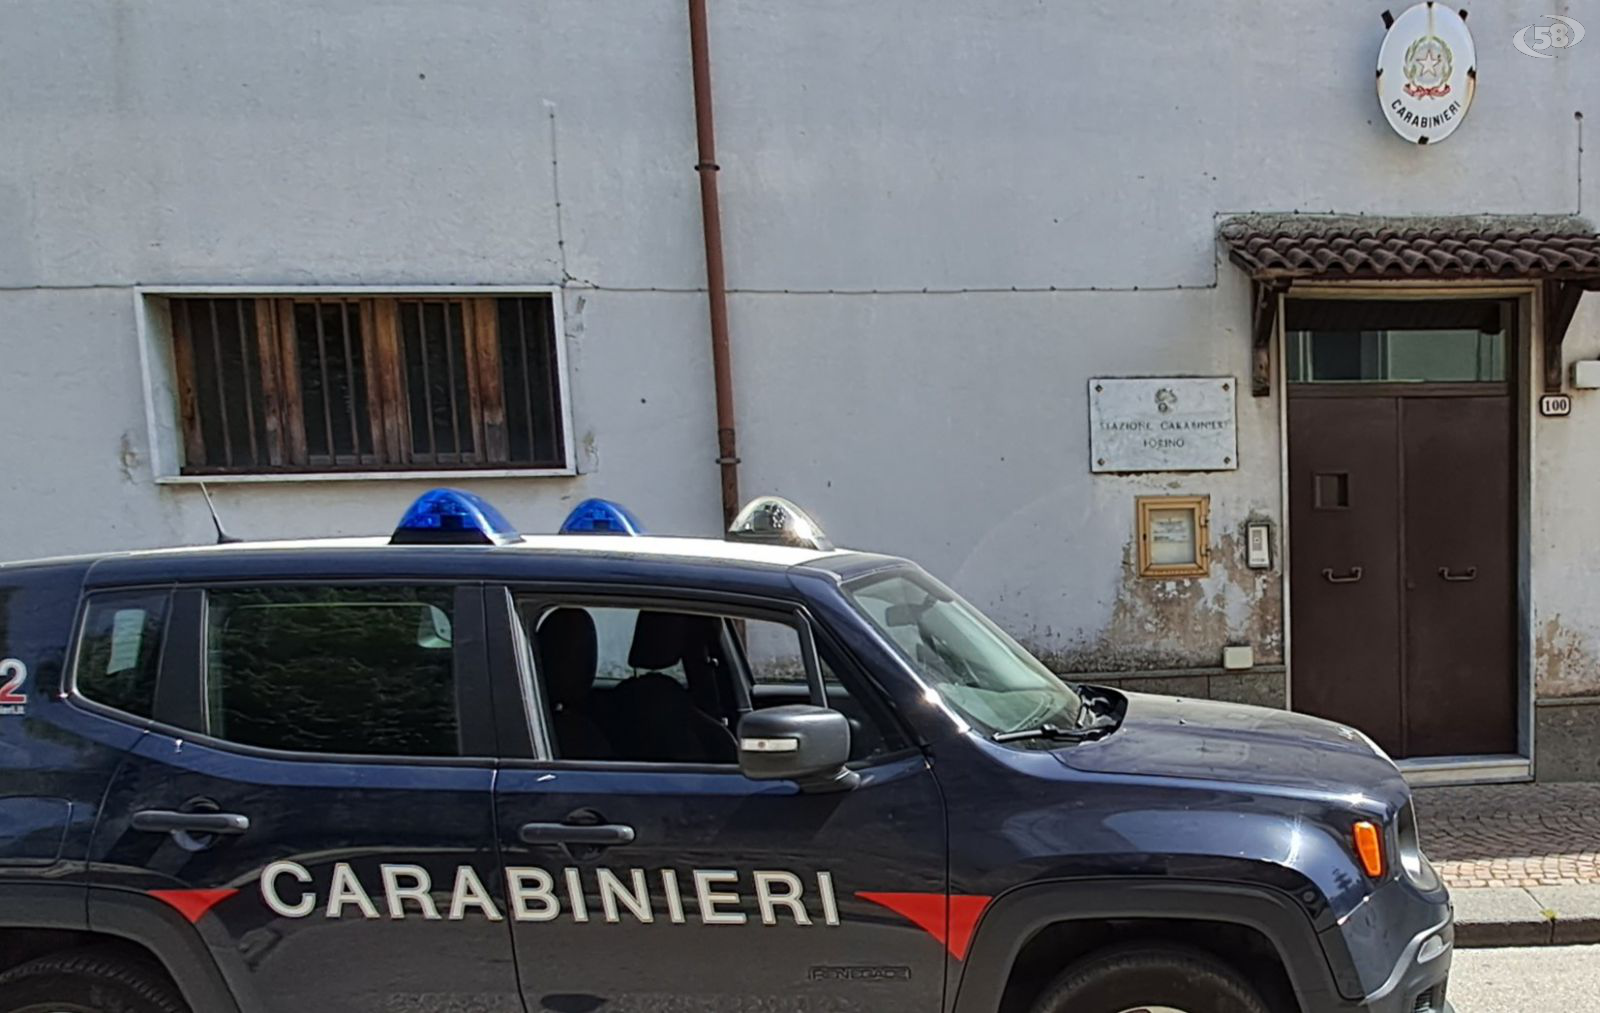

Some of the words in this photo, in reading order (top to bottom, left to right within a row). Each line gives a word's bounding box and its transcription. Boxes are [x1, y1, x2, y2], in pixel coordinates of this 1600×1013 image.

[1391, 99, 1462, 129] CARABINIERI
[1545, 399, 1567, 412] 100
[259, 860, 841, 926] CARABINIERI
